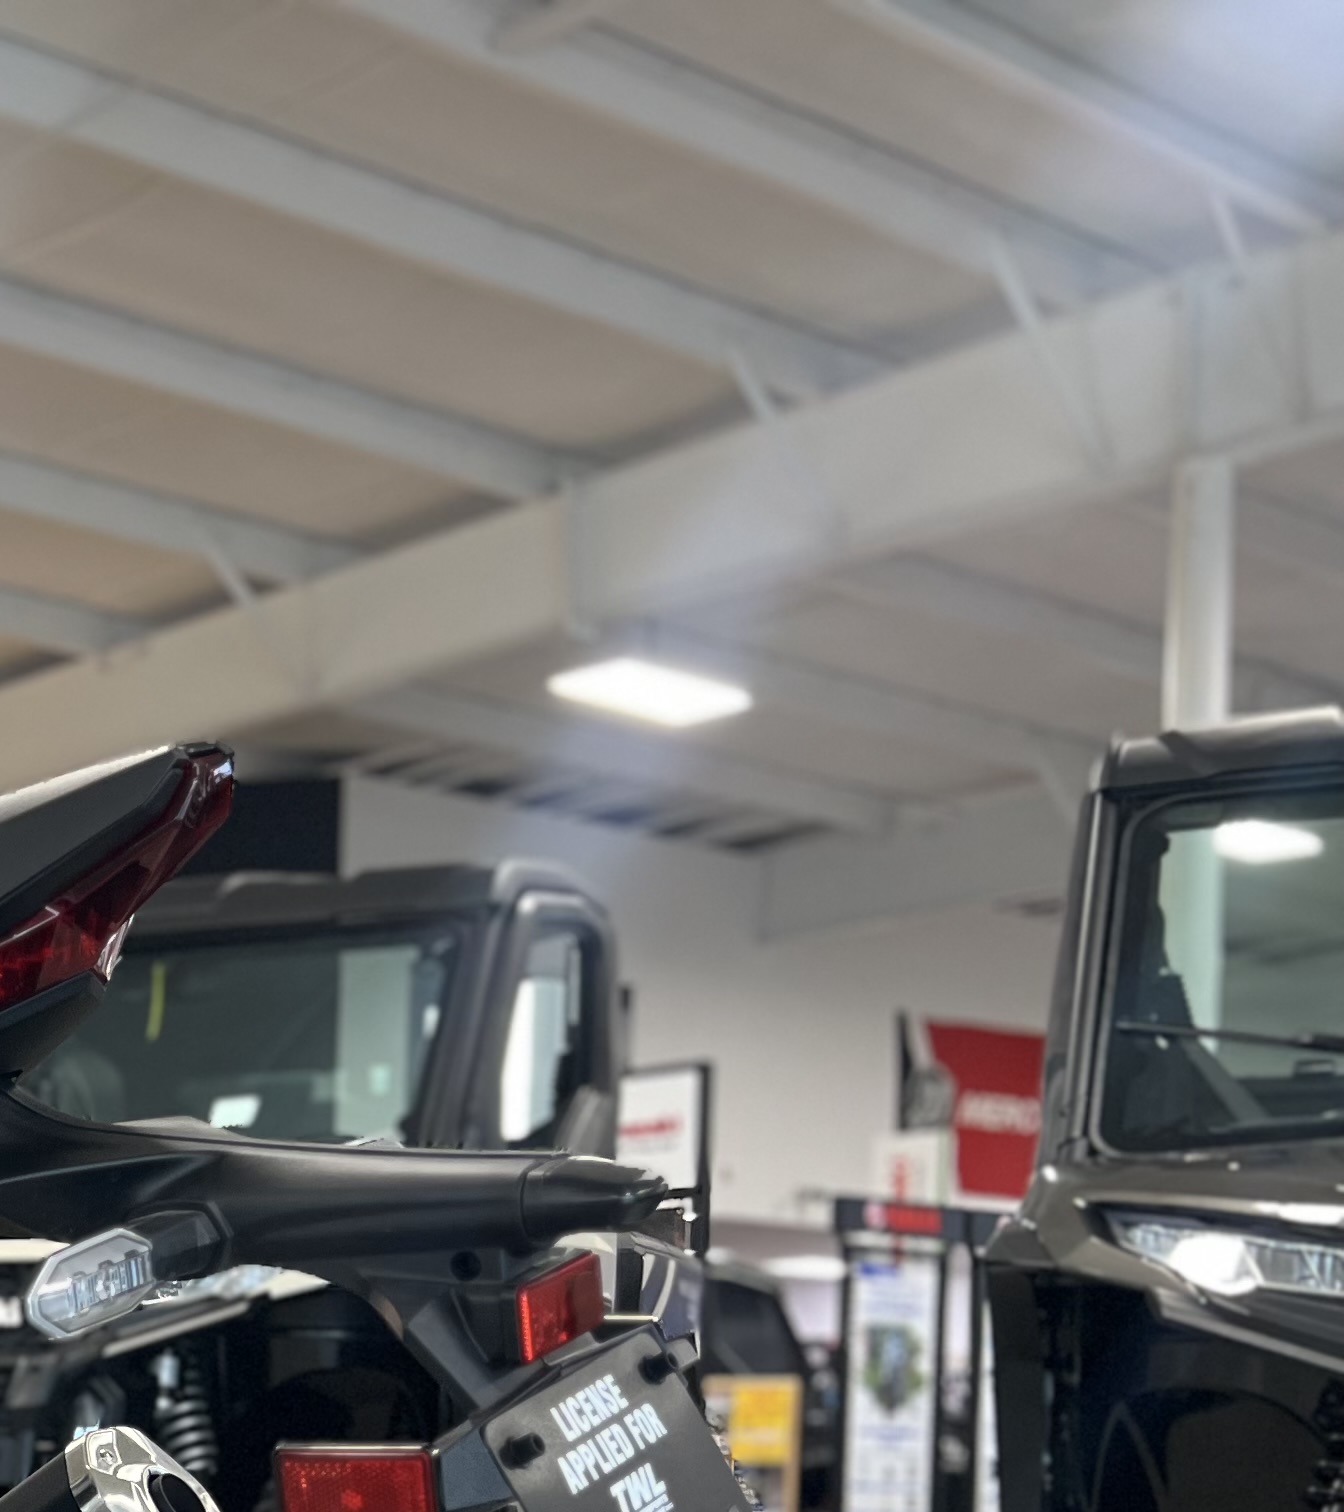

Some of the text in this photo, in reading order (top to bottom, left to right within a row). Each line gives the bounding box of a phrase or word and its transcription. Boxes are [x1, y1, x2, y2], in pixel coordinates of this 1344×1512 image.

[549, 1374, 629, 1442] LICENSE
[557, 1403, 668, 1495] APPLIED FOR
